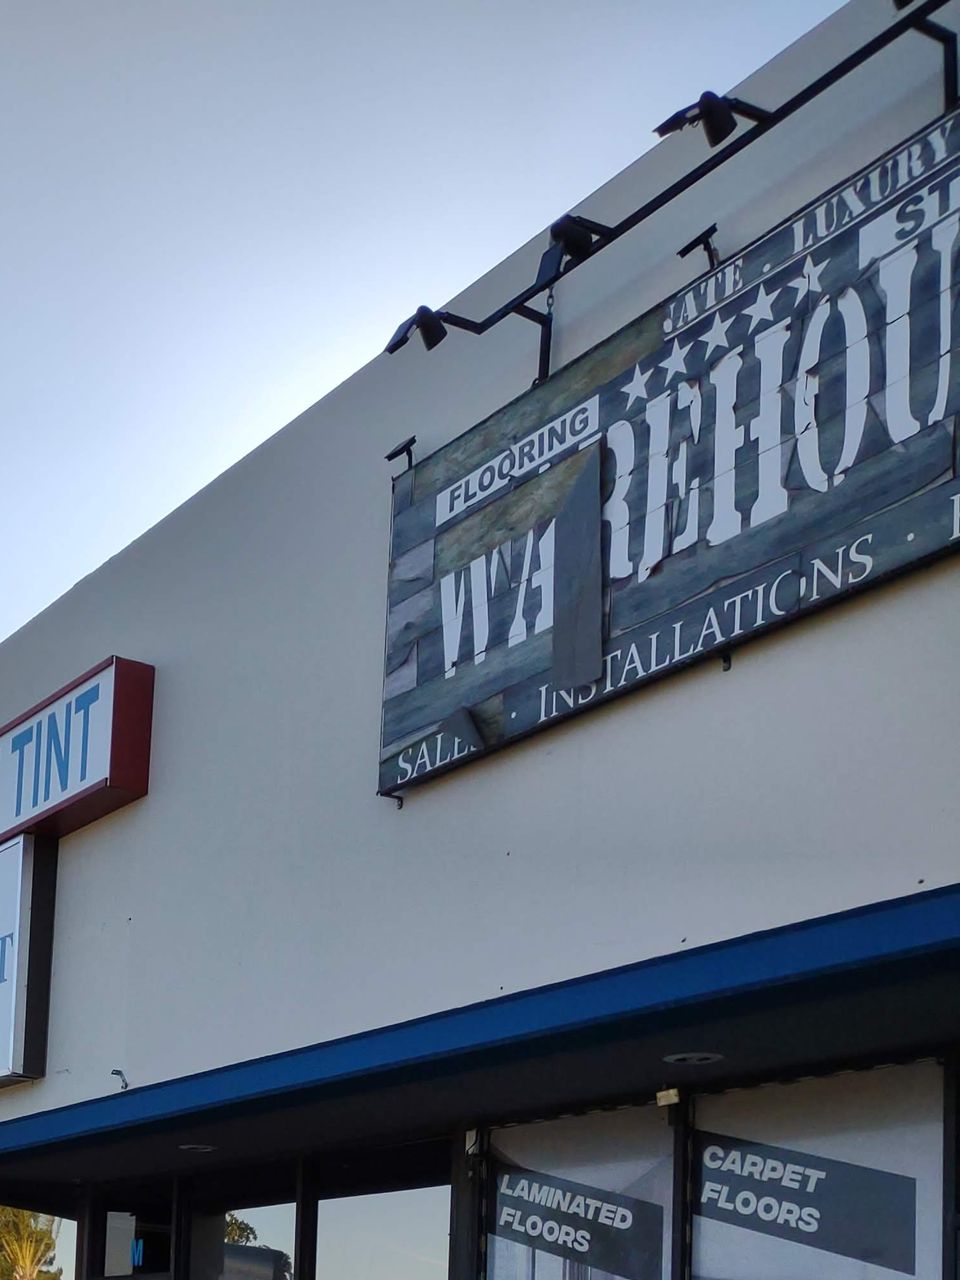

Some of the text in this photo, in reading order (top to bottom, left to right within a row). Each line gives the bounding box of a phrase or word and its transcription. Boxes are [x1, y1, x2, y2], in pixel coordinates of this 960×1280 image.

[792, 121, 954, 254] LUXURY
[449, 406, 589, 514] FLOORING
[11, 683, 100, 818] TINT
[397, 732, 477, 784] SALE
[702, 1144, 827, 1194] CARPET
[498, 1206, 591, 1254] FLOORS
[499, 1173, 633, 1232] LAMINATED
[700, 1180, 821, 1233] FLOORS
